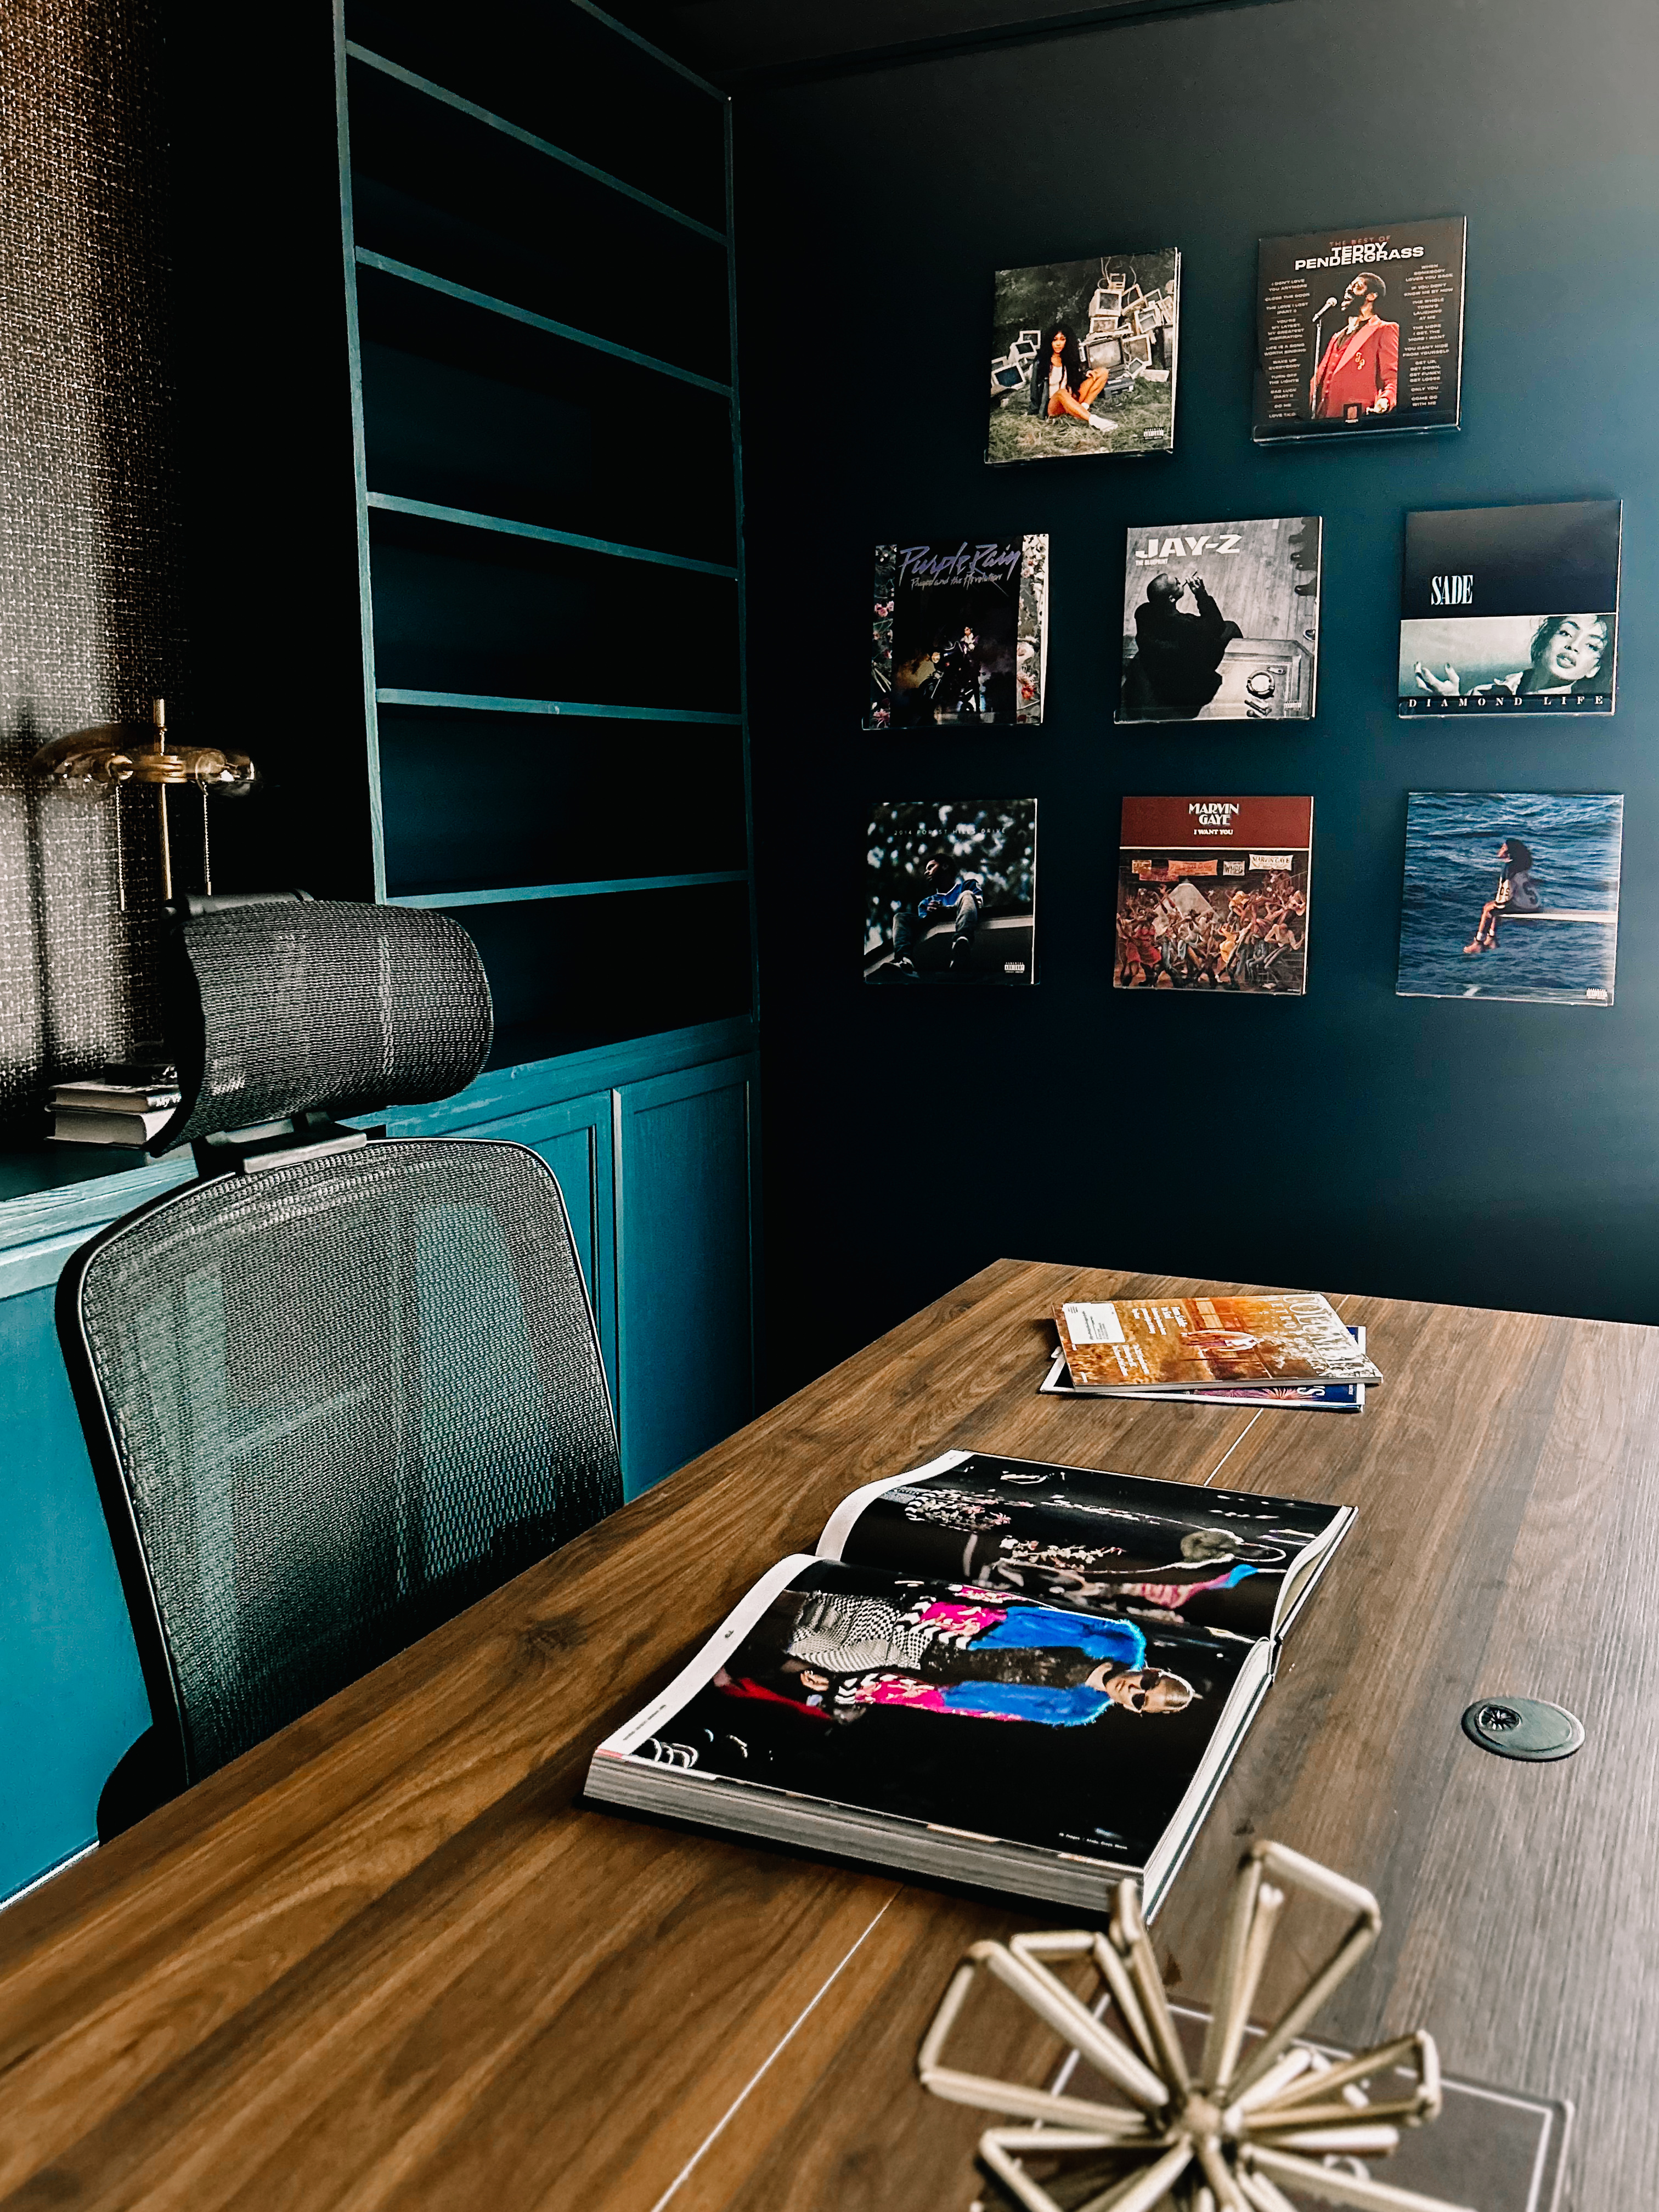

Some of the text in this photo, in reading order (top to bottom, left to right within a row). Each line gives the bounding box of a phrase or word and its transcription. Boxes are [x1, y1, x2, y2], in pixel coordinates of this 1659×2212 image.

[1295, 246, 1424, 270] PENDERGRASS
[1331, 242, 1387, 257] TEDDY
[1136, 534, 1242, 558] JAY-Z
[899, 542, 1020, 589] Purple Rain
[1431, 575, 1473, 605] SADE
[1408, 696, 1604, 707] DIAMOND LIFE
[1189, 803, 1239, 815] MARVIN
[1199, 814, 1230, 825] GAYE
[156, 1098, 170, 1107] My
[1283, 1296, 1374, 1377] COLUMBIA
